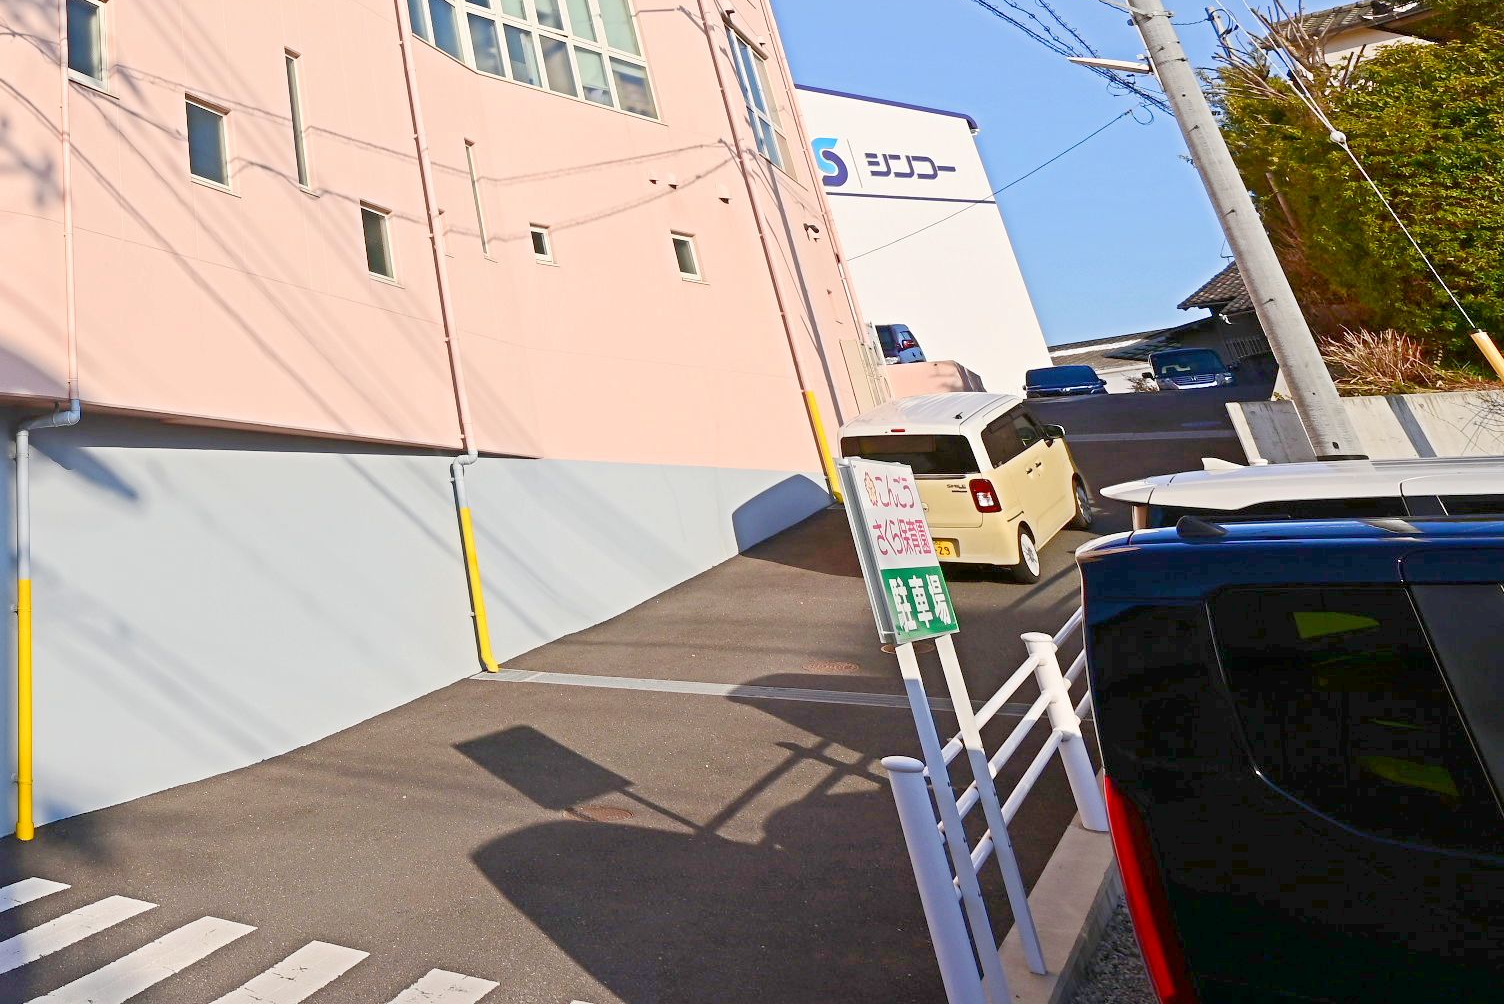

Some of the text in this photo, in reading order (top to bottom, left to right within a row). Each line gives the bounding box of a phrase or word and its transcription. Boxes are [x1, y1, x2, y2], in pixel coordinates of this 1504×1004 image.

[865, 153, 957, 180] シンコー
[875, 474, 916, 509] こんごう
[872, 518, 933, 556] さくら保育園
[888, 574, 953, 633] 駐車場
